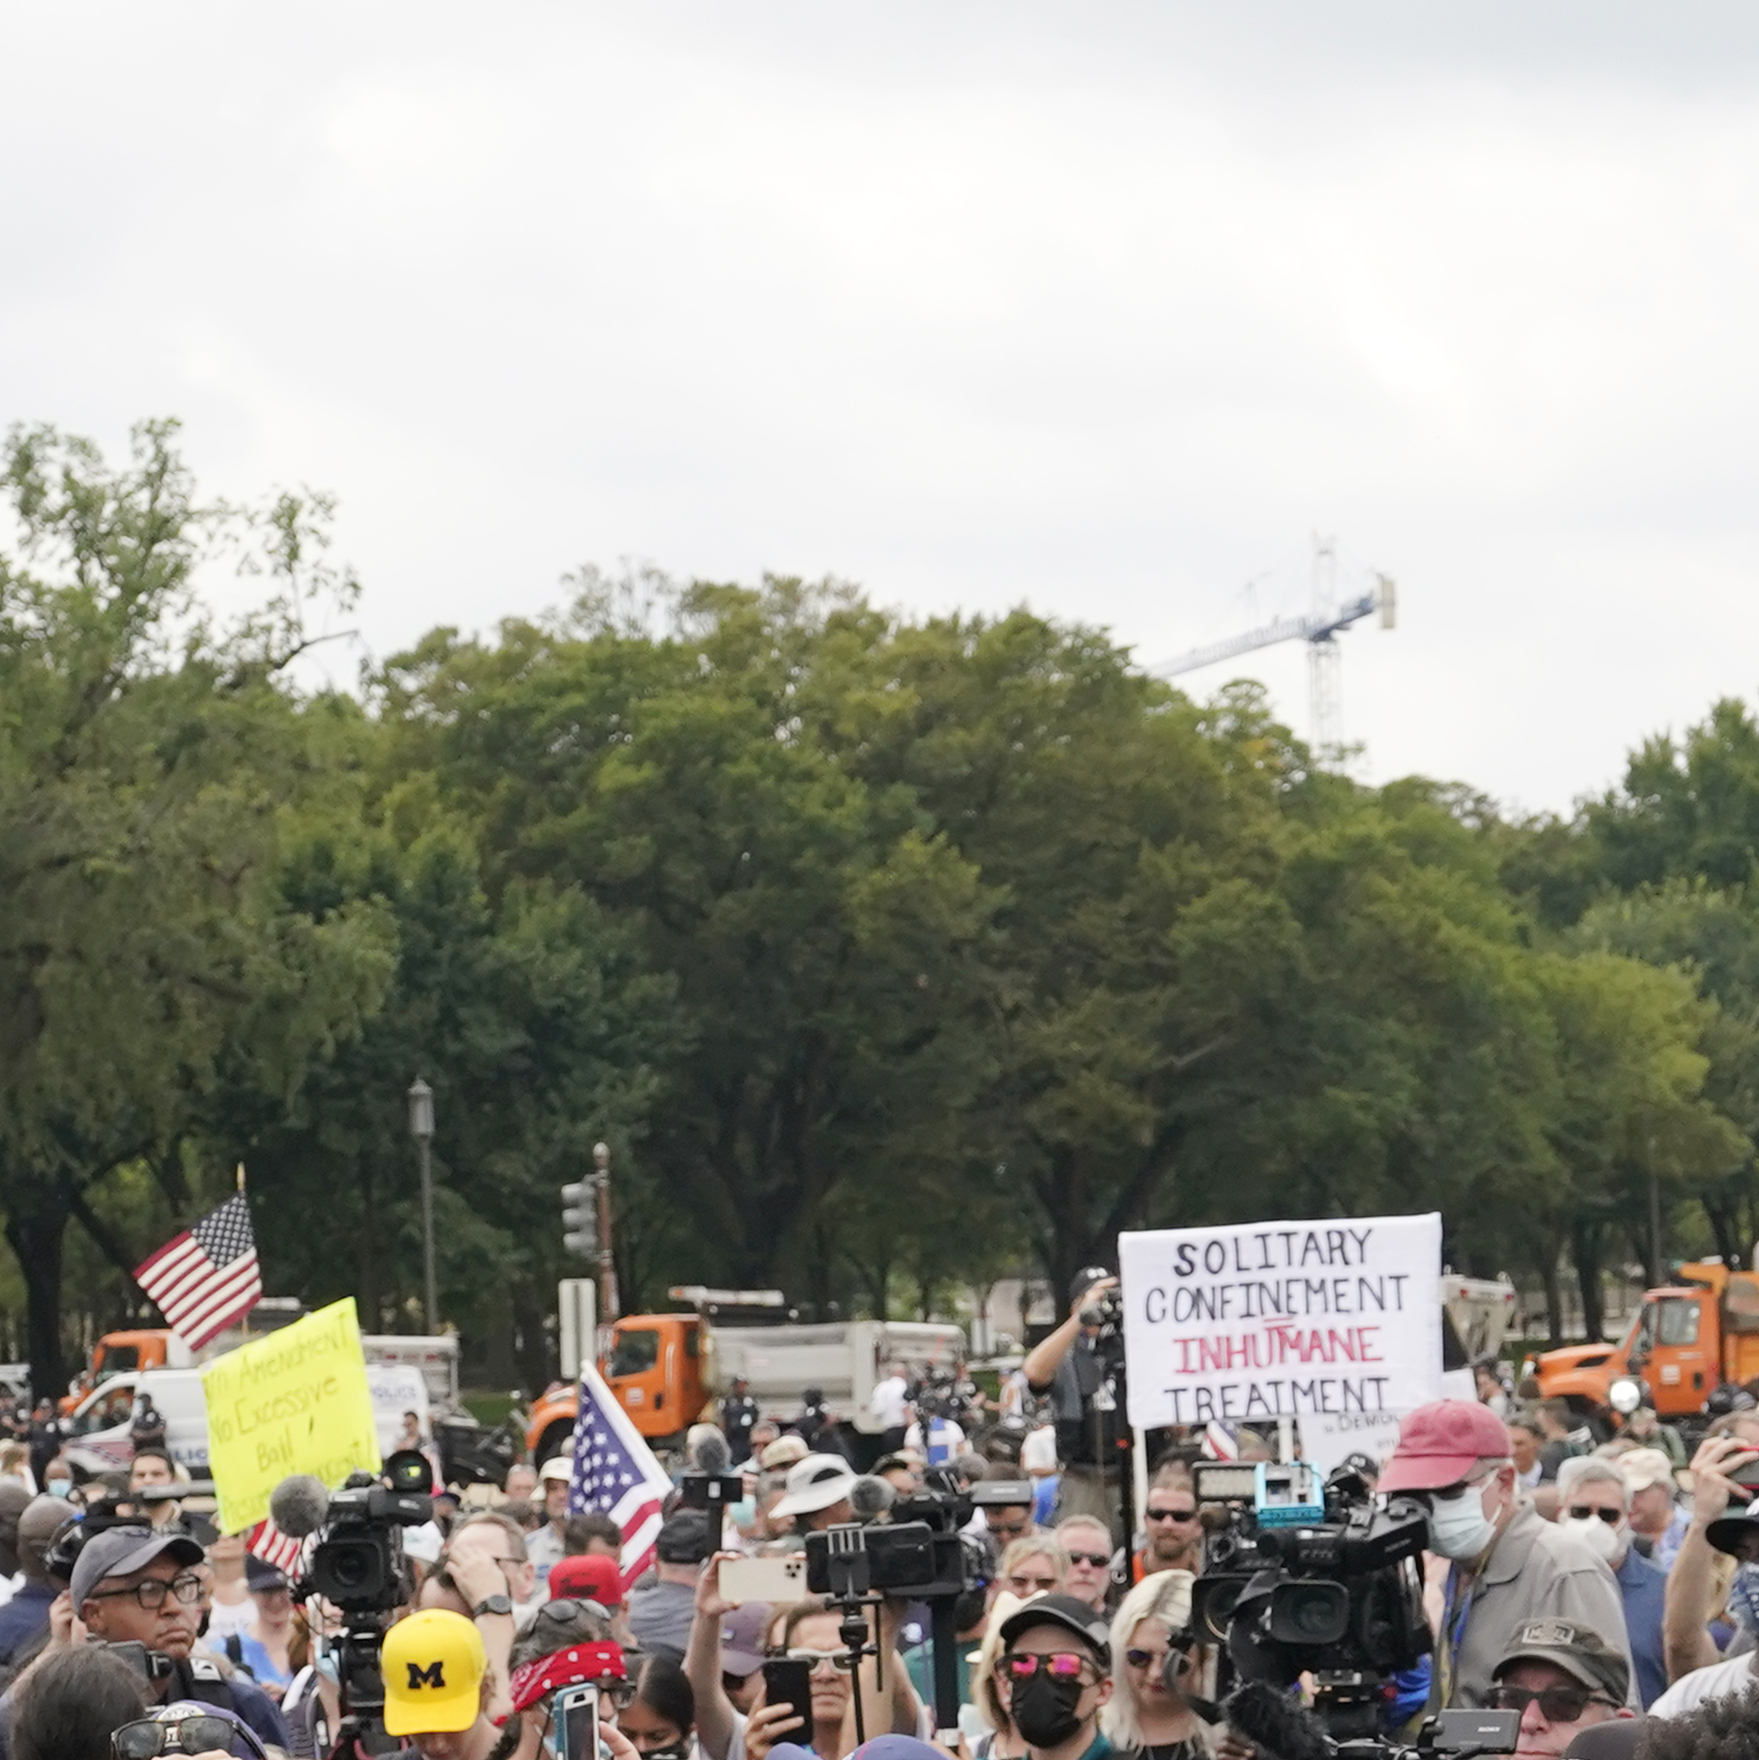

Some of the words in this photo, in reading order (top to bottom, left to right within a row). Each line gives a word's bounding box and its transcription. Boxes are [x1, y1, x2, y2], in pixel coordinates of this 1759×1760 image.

[1173, 1229, 1372, 1277] SOLITARY
[1146, 1275, 1410, 1324] CONFINEMENT
[1173, 1325, 1383, 1374] INHUMANE
[1164, 1377, 1389, 1424] TREATMENT
[406, 1661, 446, 1689] M
